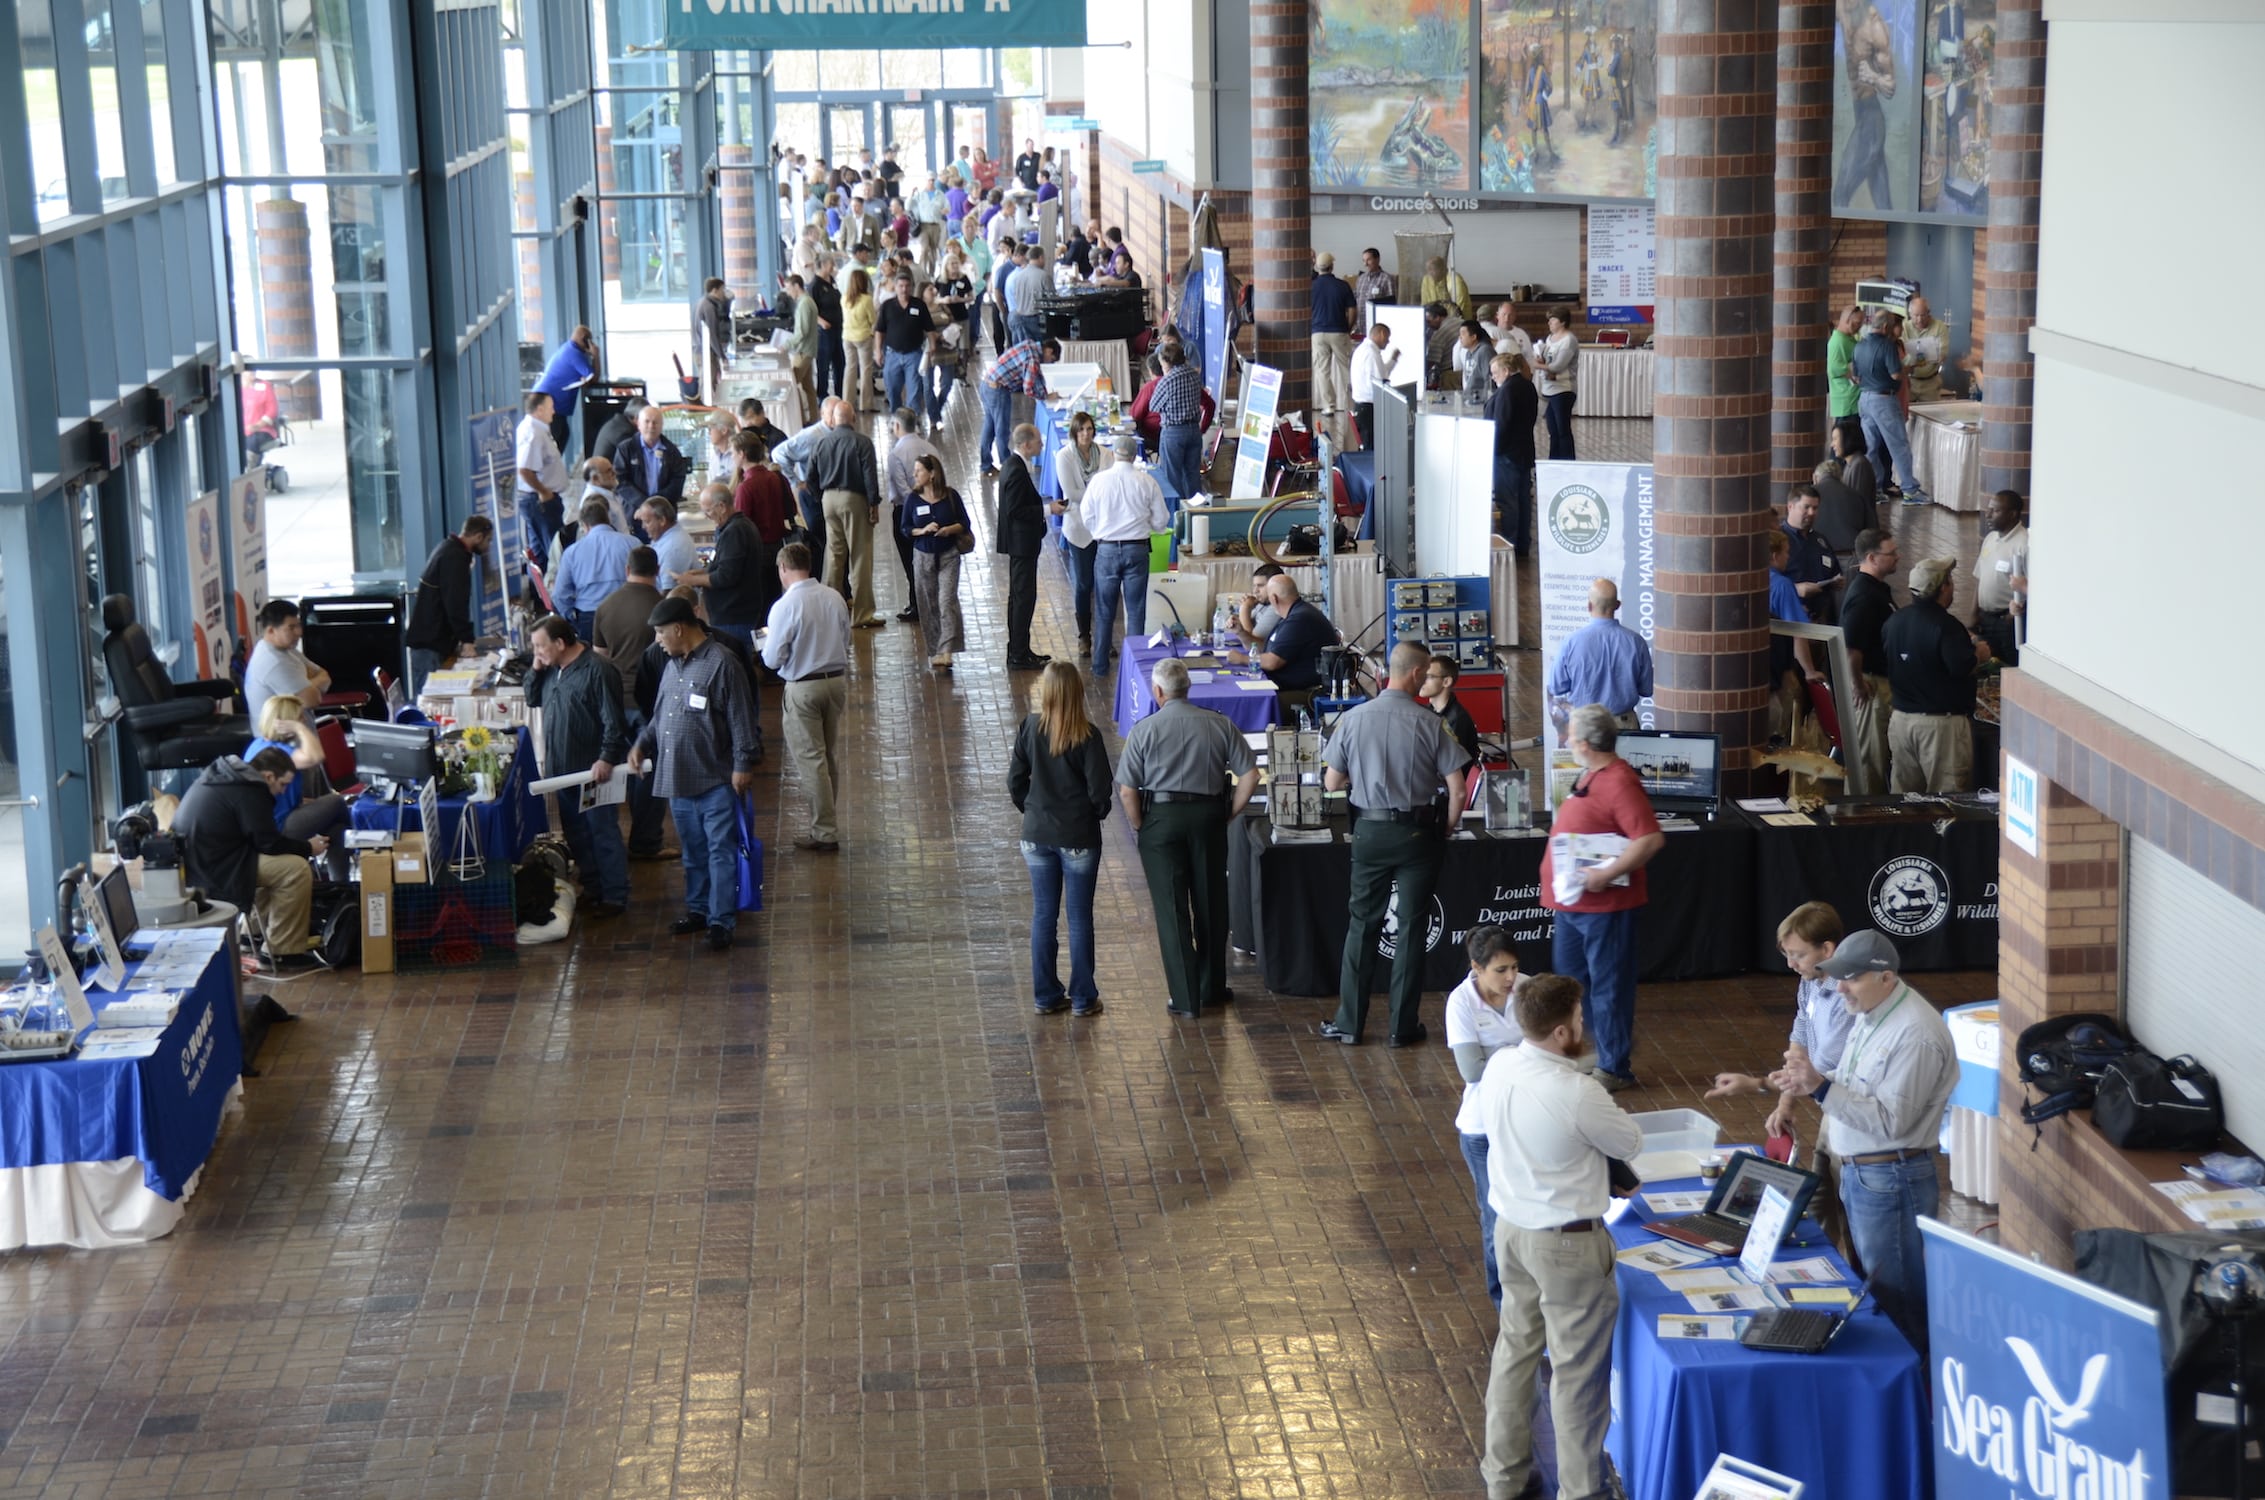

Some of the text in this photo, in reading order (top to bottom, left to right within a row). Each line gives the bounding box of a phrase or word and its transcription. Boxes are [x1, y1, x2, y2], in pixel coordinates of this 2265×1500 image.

[1371, 196, 1478, 210] Concessions
[1559, 485, 1597, 500] LOUISIANA
[1550, 524, 1574, 552] WILDLIFE
[1582, 526, 1608, 552] FISHERIES
[1638, 474, 1653, 587] MANAGEMENT
[1544, 583, 1571, 591] ESSENTIAL
[1640, 591, 1654, 641] GOOD
[2010, 767, 2033, 816] ATM
[1884, 859, 1932, 875] LOUISIANA
[1873, 903, 1903, 933] WILDLIFE
[1912, 901, 1946, 932] FISHERIES
[1513, 924, 1542, 941] and
[1943, 1356, 2151, 1500] Sea Grant
